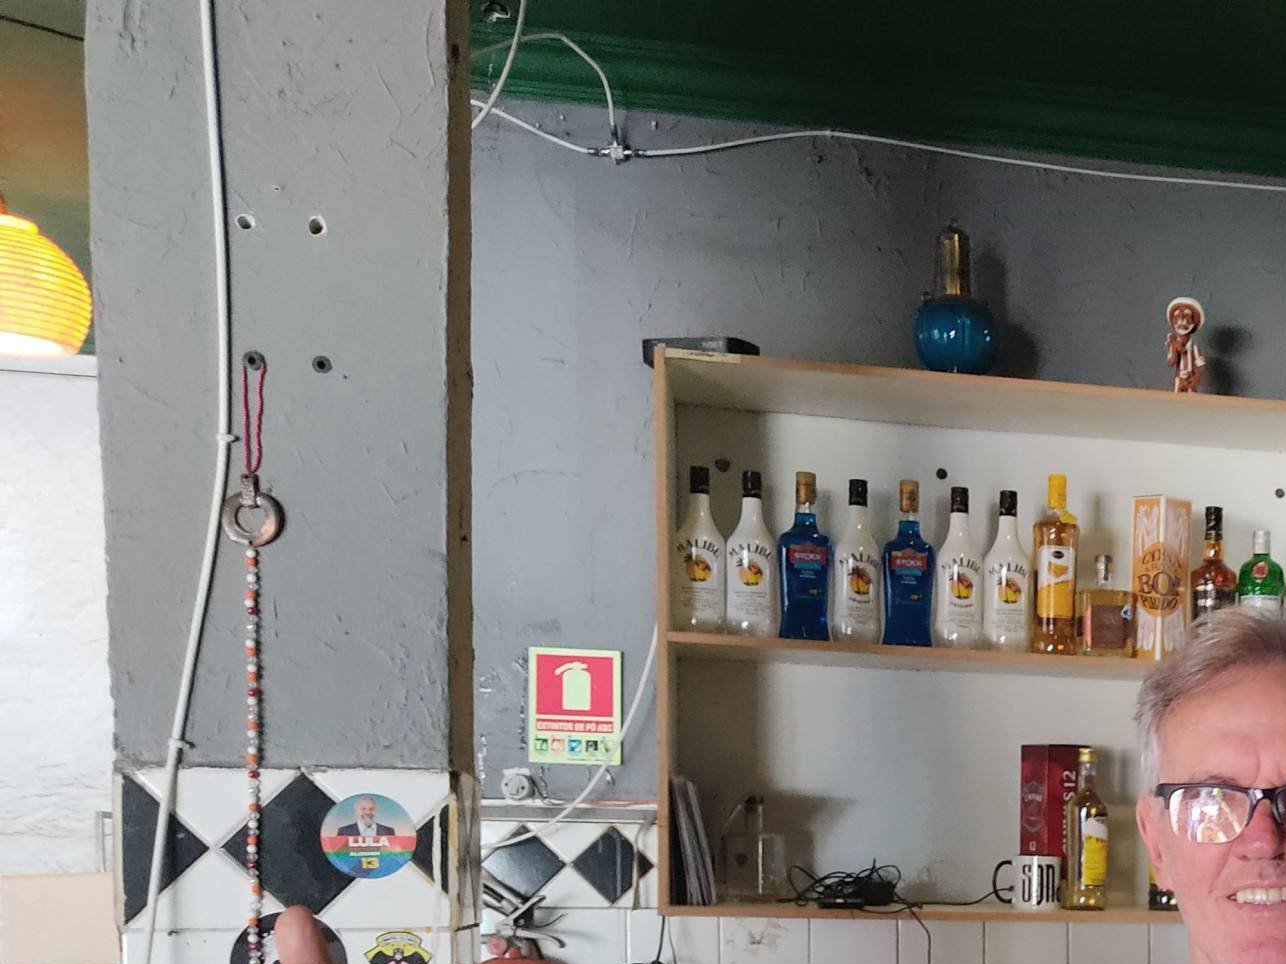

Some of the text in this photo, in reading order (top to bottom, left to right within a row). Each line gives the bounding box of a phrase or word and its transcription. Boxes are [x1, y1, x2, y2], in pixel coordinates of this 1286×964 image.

[795, 552, 821, 560] STOCK
[895, 558, 922, 567] STOCK
[349, 836, 389, 847] LULA
